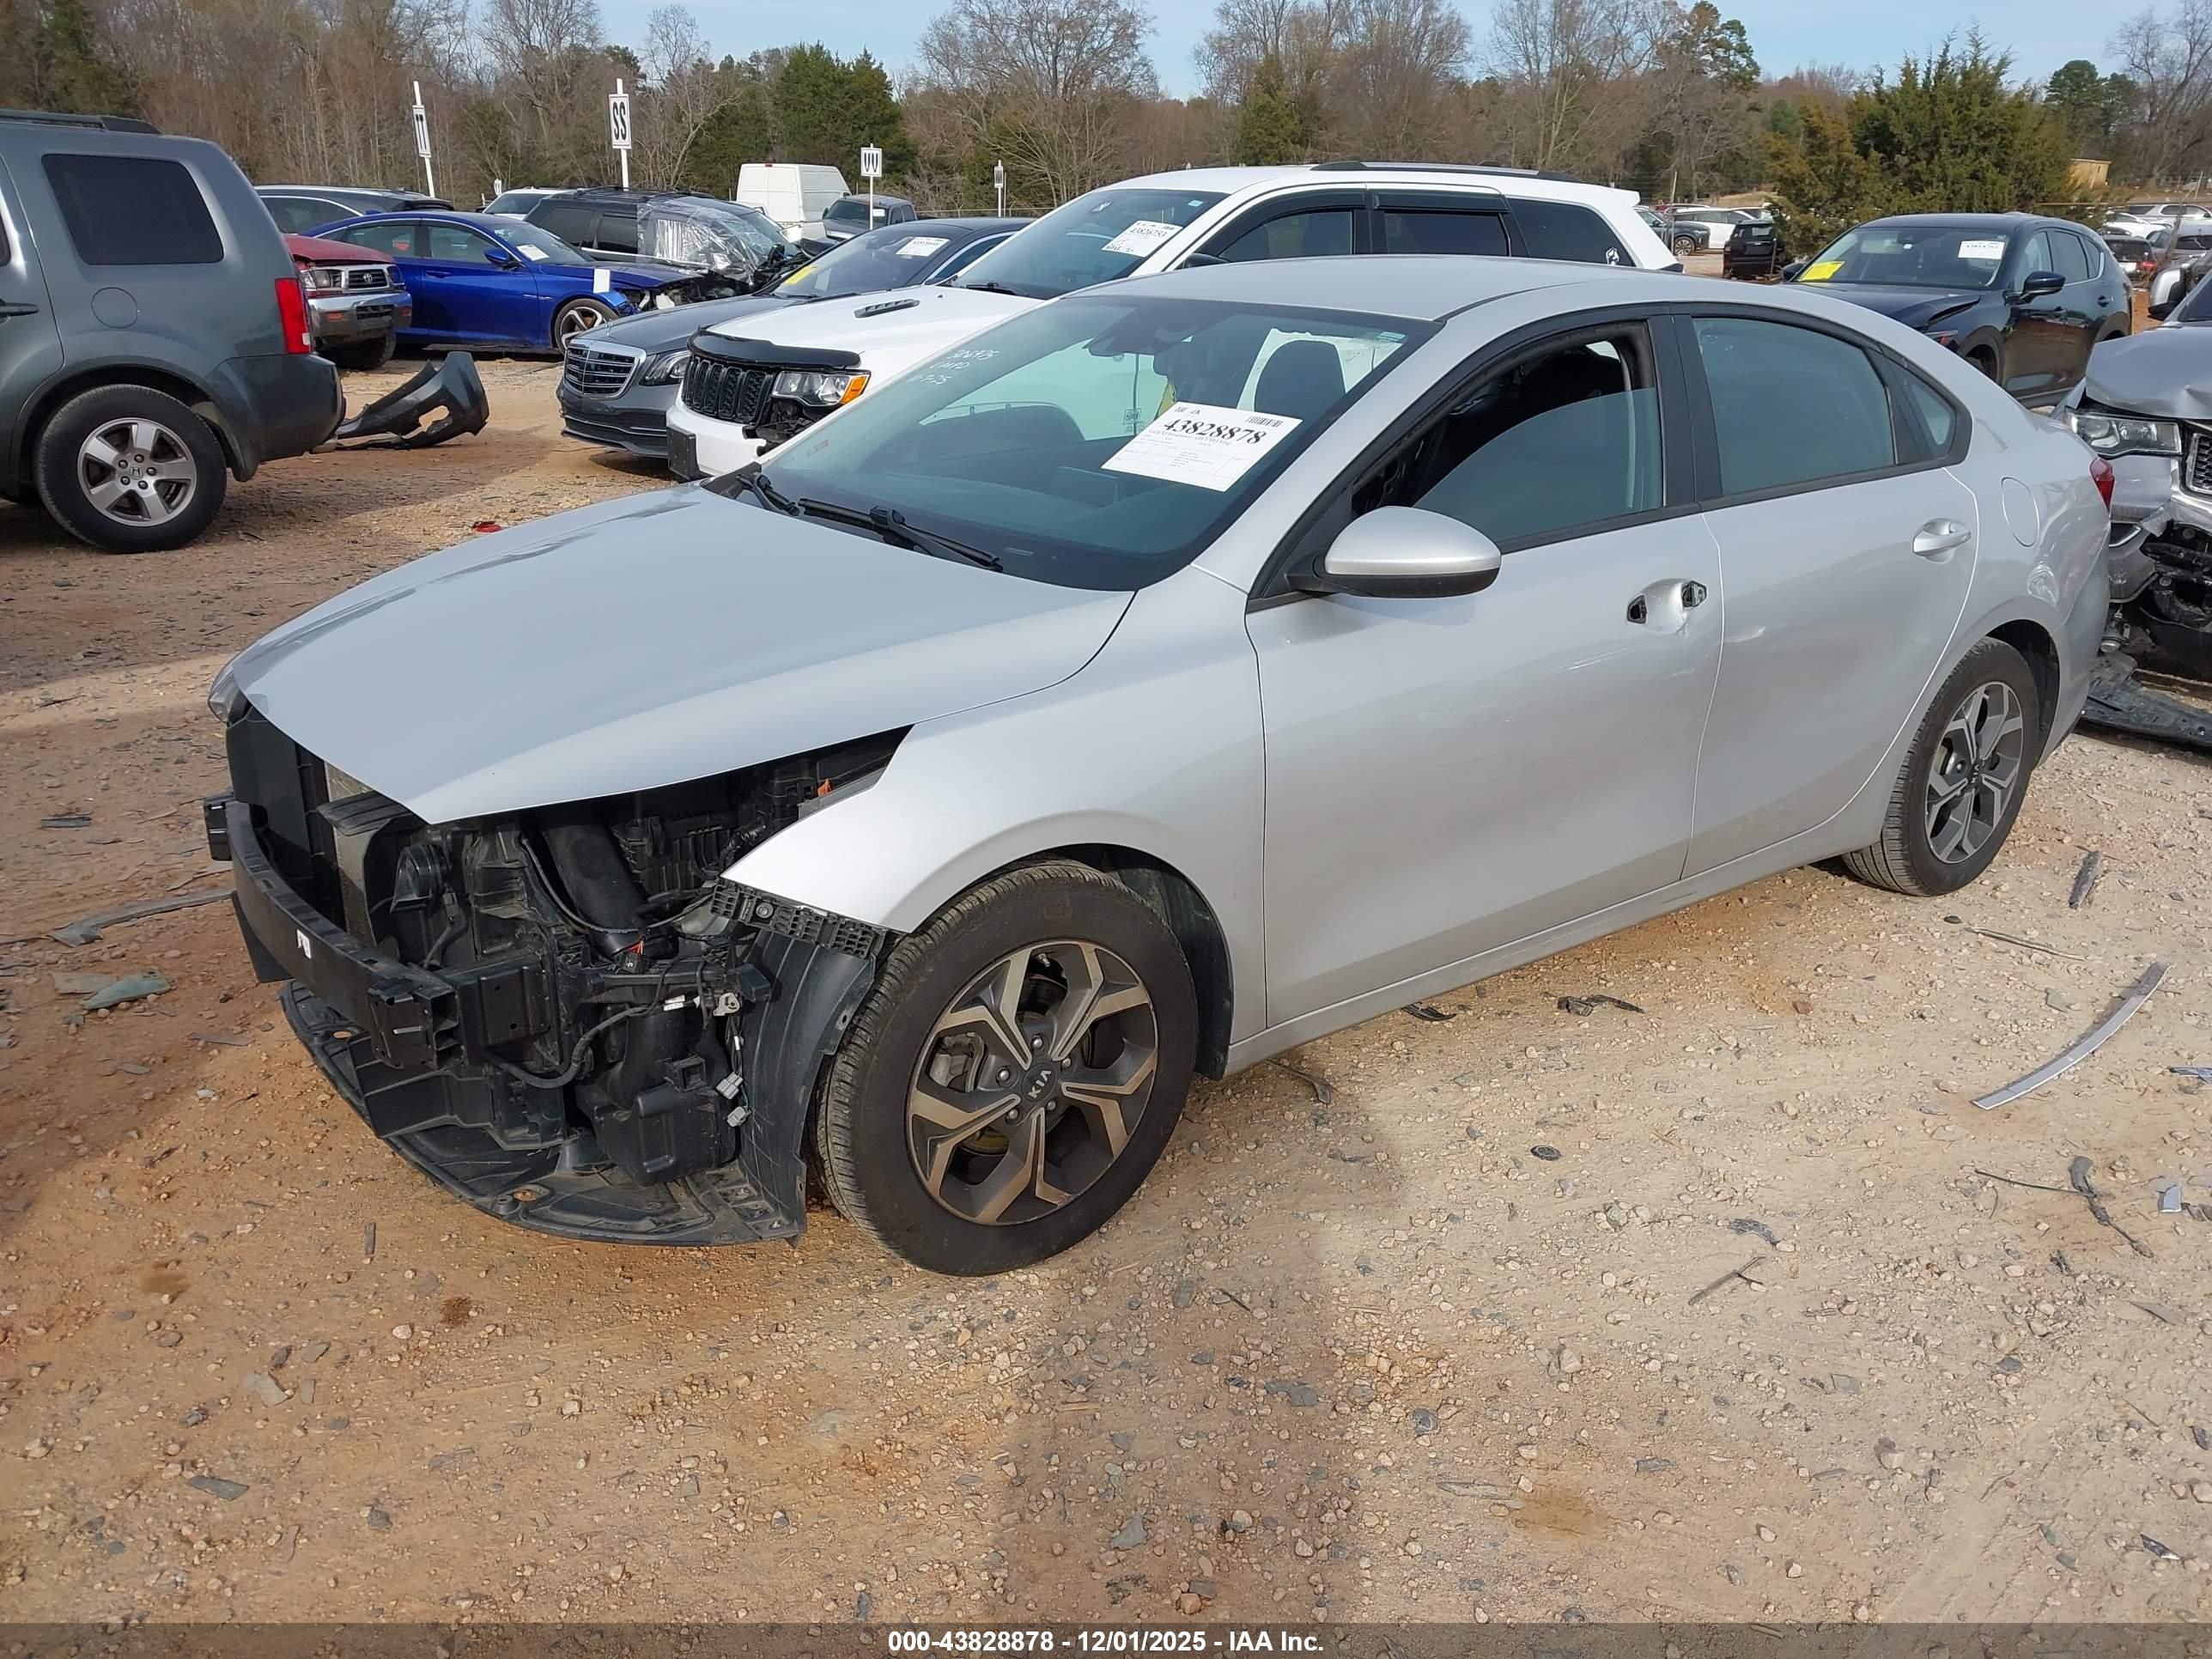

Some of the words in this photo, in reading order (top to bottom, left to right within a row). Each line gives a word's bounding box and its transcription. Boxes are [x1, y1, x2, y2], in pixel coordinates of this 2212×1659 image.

[612, 101, 627, 141] SS
[1164, 418, 1267, 445] 43828878
[1028, 1070, 1052, 1098] KIA
